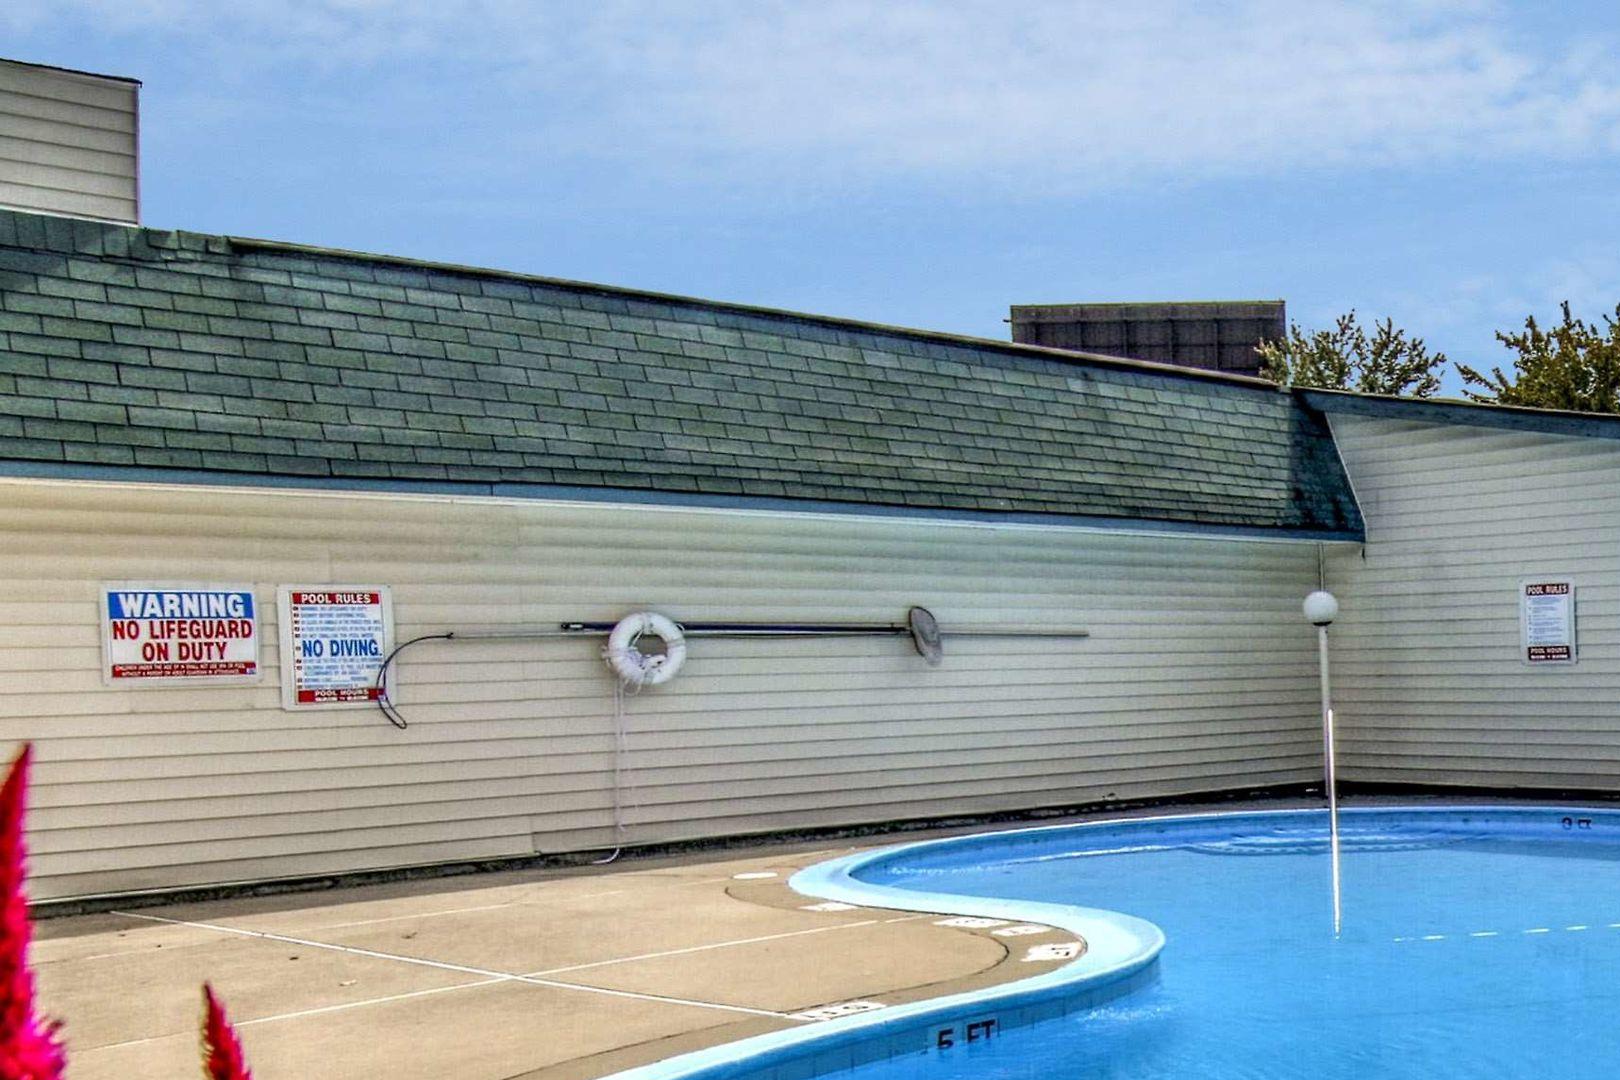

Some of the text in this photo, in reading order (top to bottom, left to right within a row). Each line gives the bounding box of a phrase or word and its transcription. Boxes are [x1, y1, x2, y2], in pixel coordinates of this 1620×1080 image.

[118, 593, 245, 618] WARNING
[301, 593, 371, 604] POOL RULES
[112, 620, 253, 640] NO LIFEGUARD
[142, 641, 227, 662] ON DUTY
[303, 639, 323, 657] NO
[937, 1019, 996, 1050] 5 FT
